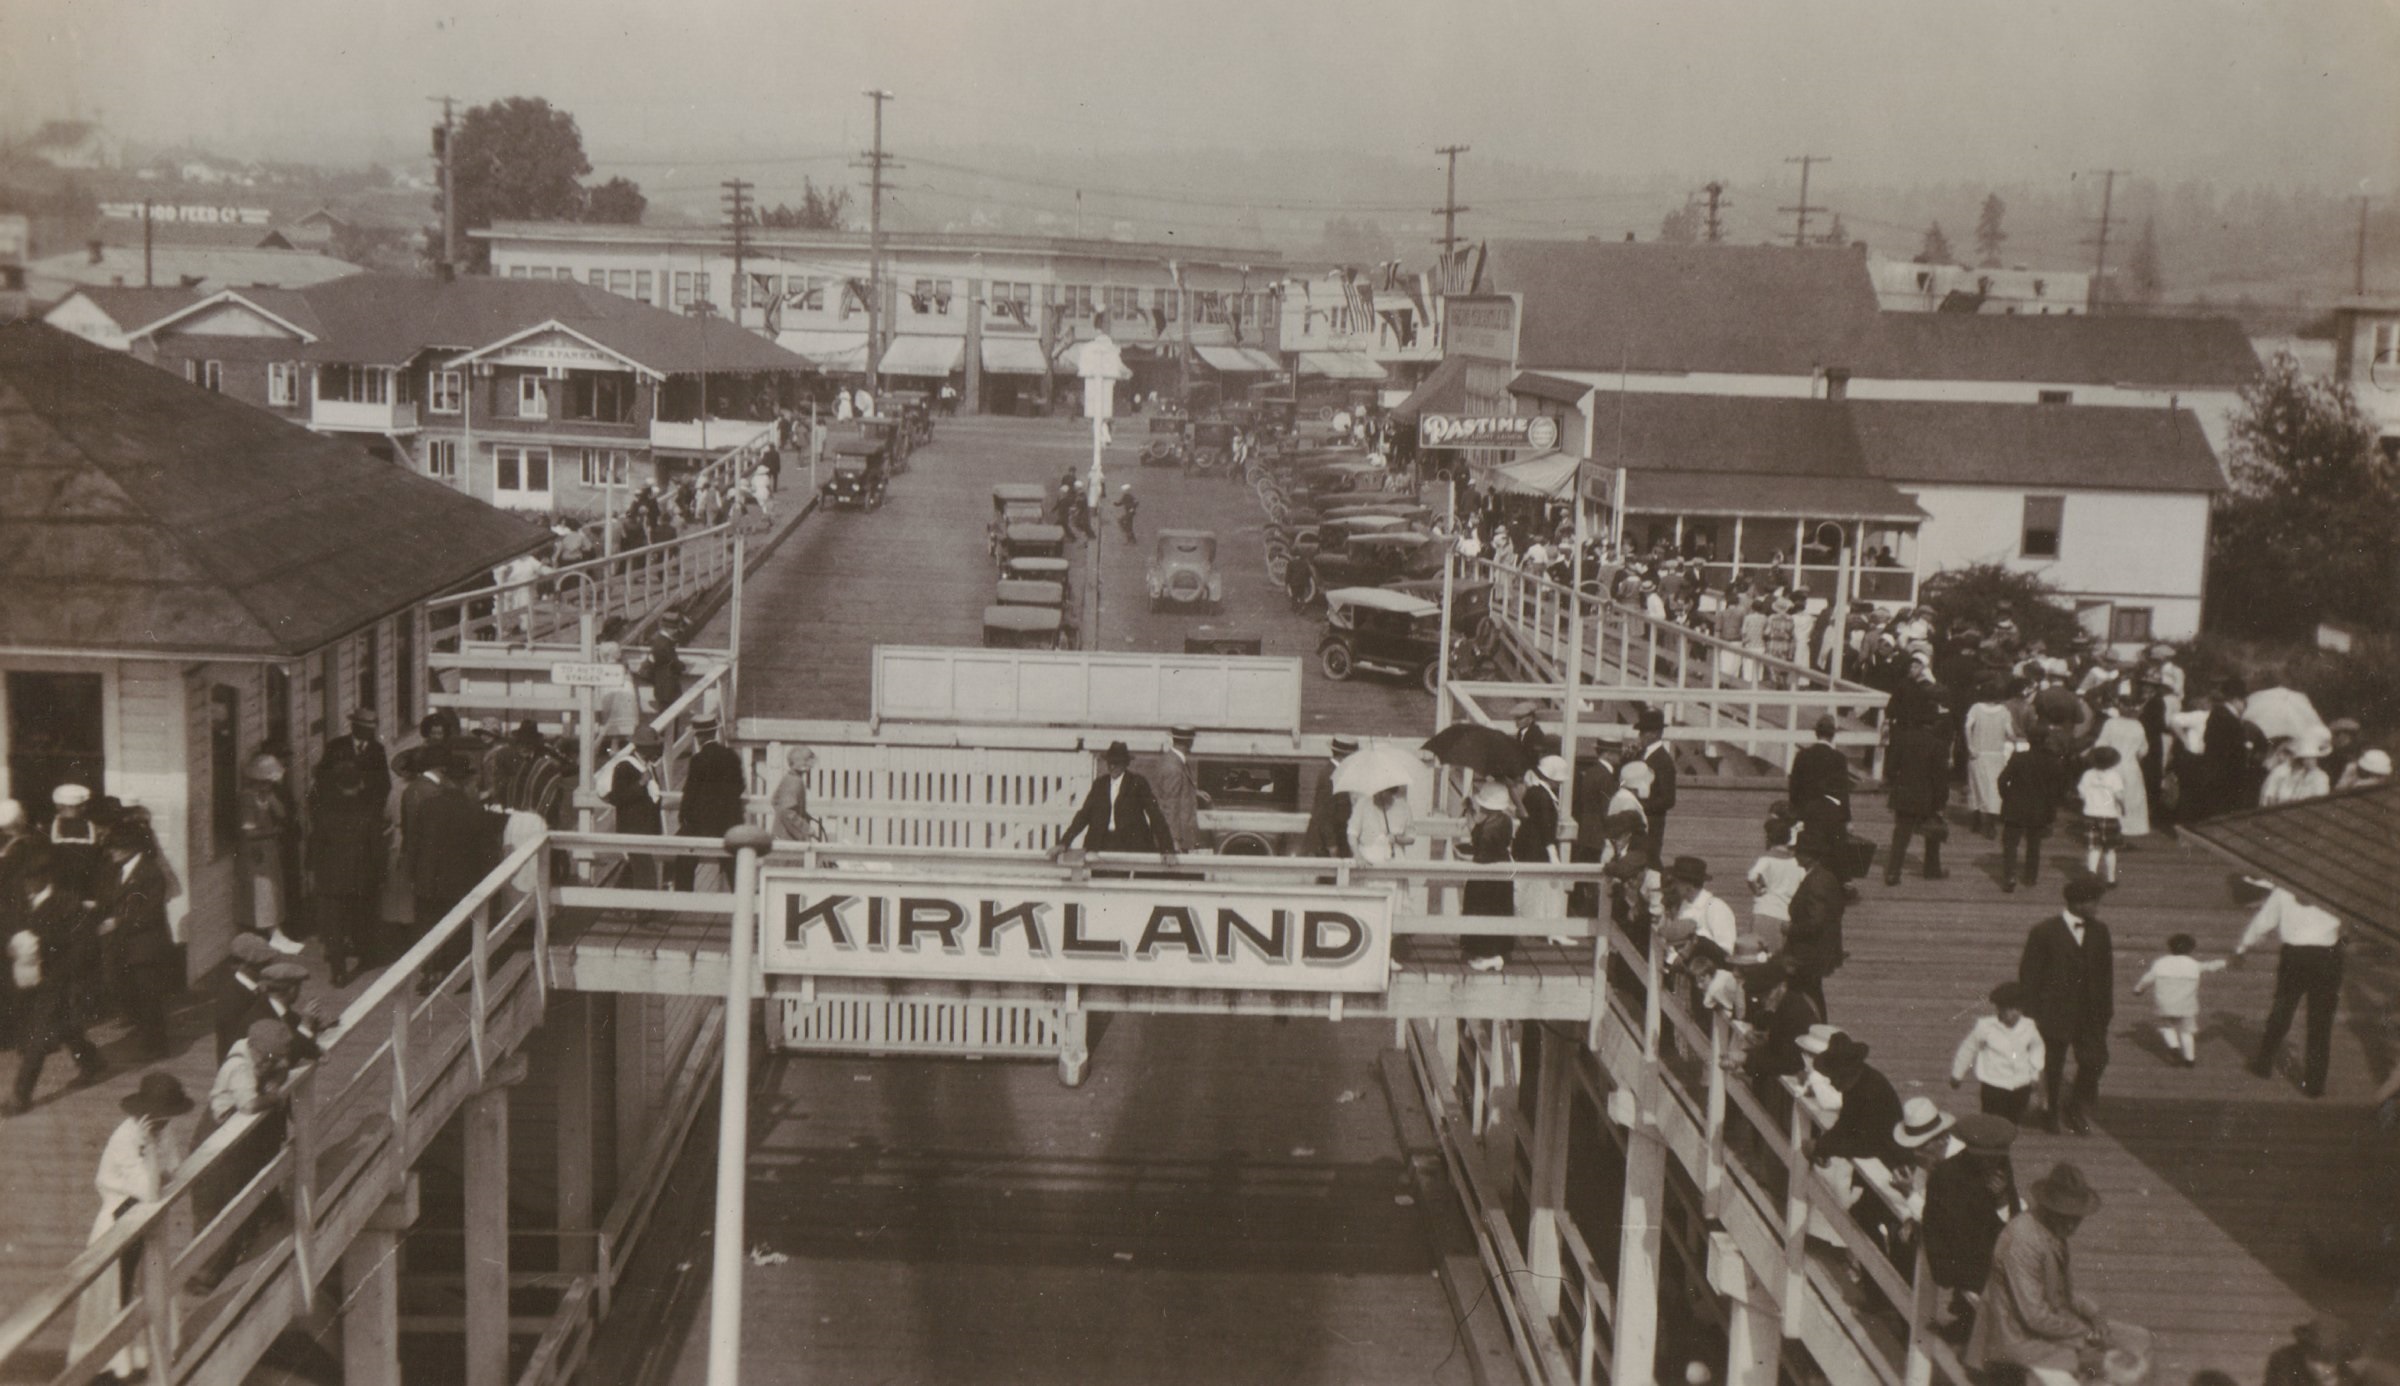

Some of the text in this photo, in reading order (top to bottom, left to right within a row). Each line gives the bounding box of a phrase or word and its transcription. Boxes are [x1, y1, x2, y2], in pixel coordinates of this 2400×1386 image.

[180, 205, 219, 223] FEED
[1423, 415, 1528, 446] PASTIME
[784, 893, 1371, 967] KIRKLAND
